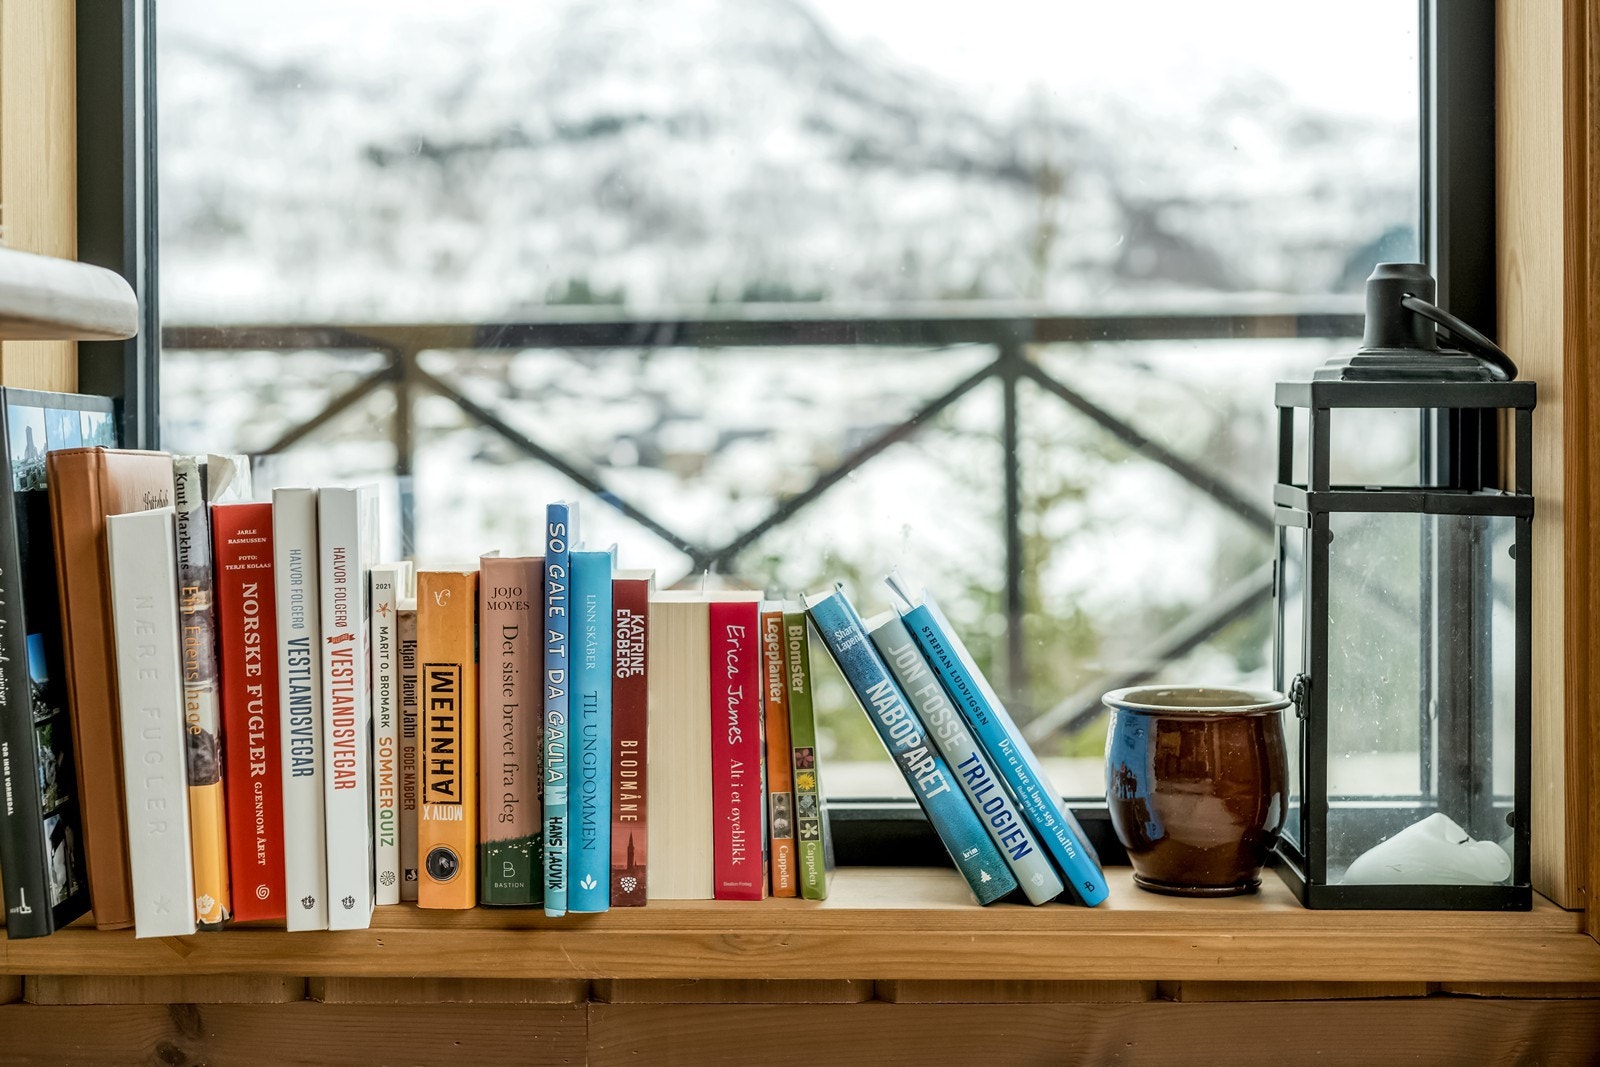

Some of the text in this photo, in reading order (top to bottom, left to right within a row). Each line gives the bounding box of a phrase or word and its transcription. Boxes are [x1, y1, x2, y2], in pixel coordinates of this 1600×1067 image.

[176, 472, 191, 570] Knut Markhus
[289, 549, 304, 630] HALVOR FOLGERØ
[334, 547, 348, 628] HALVOR FOLGERØ
[487, 601, 530, 611] MOYES
[491, 587, 522, 599] JOJO
[184, 626, 202, 680] Edens
[547, 522, 566, 783] SO GALE AT DA GAULA
[586, 594, 597, 670] LINN SKÅBER
[616, 609, 631, 679] ENGBERG
[630, 615, 645, 676] KATRINE
[763, 617, 783, 704] Legeplanter
[788, 625, 806, 694] Blomster
[134, 596, 168, 836] NÆRE FUGLER
[242, 582, 266, 777] NORSKE FUGLER
[287, 636, 314, 778] VESTLANDSVEGAR
[379, 626, 390, 728] MARIT O. BROMARK
[402, 674, 417, 706] David
[726, 624, 745, 745] Erica James
[887, 642, 968, 751] JON FOSSE
[921, 626, 989, 727] STEFFAN LUDVIGSEN
[331, 648, 357, 790] VESTLANDSVEGAR
[403, 710, 417, 738] Jahn
[498, 624, 519, 824] Det siste brevet fra deg
[866, 677, 951, 800] NABOPARET
[5, 777, 14, 816] VORMEDAL
[379, 737, 394, 847] SOMMERQUIZ
[403, 746, 415, 811] GODE NABOER
[581, 690, 597, 851] TIL UNGDOMMEN
[620, 740, 642, 822] BLODMÅNE
[730, 758, 744, 779] Alt
[730, 791, 741, 803] et
[957, 751, 1034, 862] TRILOGIEN
[997, 737, 1013, 757] Det
[1008, 756, 1018, 766] er
[1014, 764, 1030, 785] bare
[1026, 782, 1035, 793] å
[1031, 790, 1046, 813] bøye
[1042, 811, 1055, 827] seg
[1055, 827, 1077, 859] hatten
[254, 781, 266, 866] GJENNOM ÅRET
[423, 805, 463, 821] MOTIV X
[549, 816, 563, 889] HANS LAUVIK
[727, 807, 746, 866] øyeblikk
[777, 845, 789, 888] Cappelen
[806, 842, 818, 886] Cappelen
